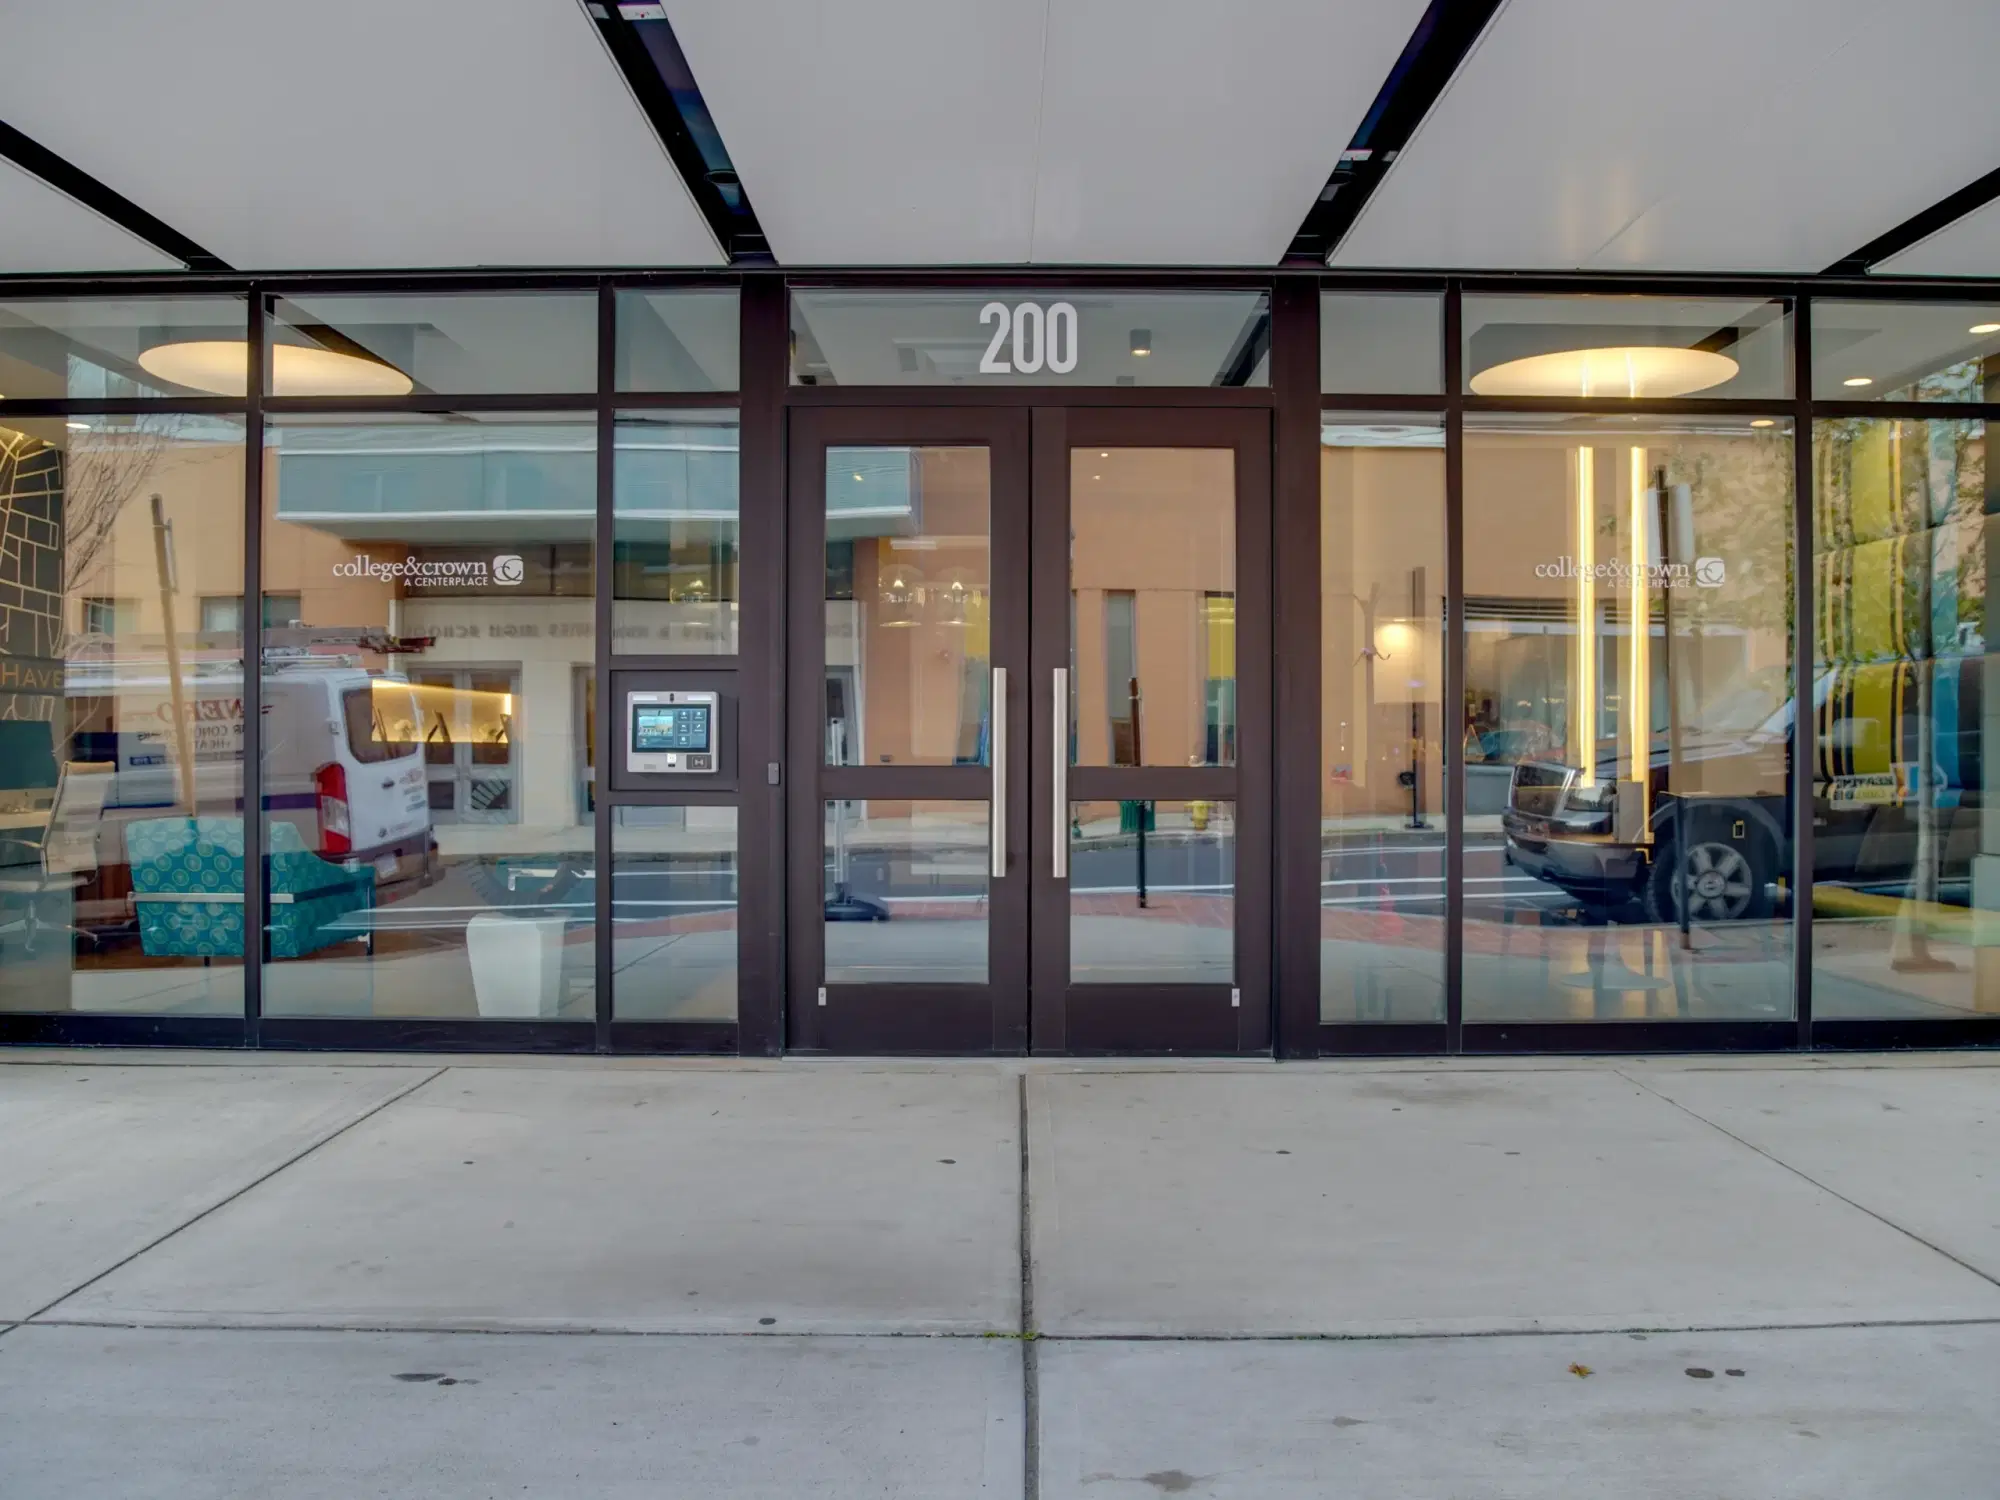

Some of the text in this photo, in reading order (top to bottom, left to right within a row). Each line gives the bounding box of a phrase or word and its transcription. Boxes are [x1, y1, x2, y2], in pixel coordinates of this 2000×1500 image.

[980, 302, 1078, 374] 200
[332, 555, 488, 582] college&crown
[404, 577, 489, 587] A CENTERPLACE
[1607, 579, 1692, 589] A CEERPLACE
